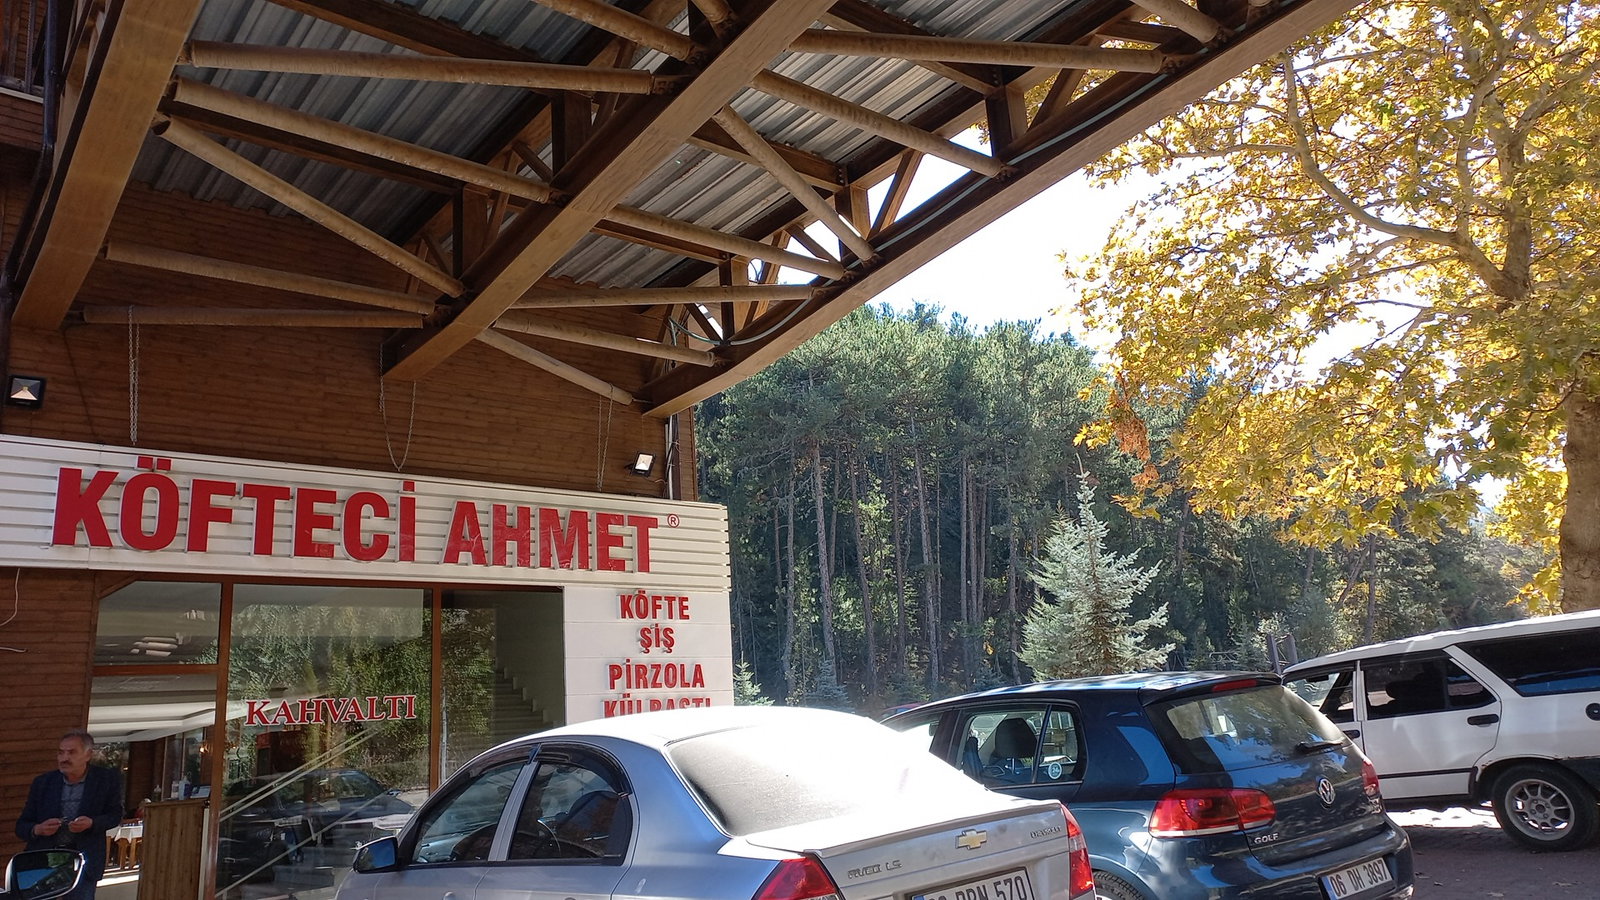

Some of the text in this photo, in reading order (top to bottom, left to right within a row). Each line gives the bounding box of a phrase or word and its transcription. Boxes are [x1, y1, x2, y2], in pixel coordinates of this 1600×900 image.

[53, 456, 416, 562] KÖFTECİ
[443, 500, 658, 573] AHMET
[620, 590, 690, 620] KÖFTE
[640, 623, 675, 654] ŞİŞ
[609, 658, 705, 690] PİRZOLA
[245, 694, 417, 726] KAHVALTI
[1254, 833, 1279, 844] GOLF
[993, 875, 1028, 900] 570
[1329, 874, 1347, 897] 06
[1363, 860, 1388, 885] 3897
